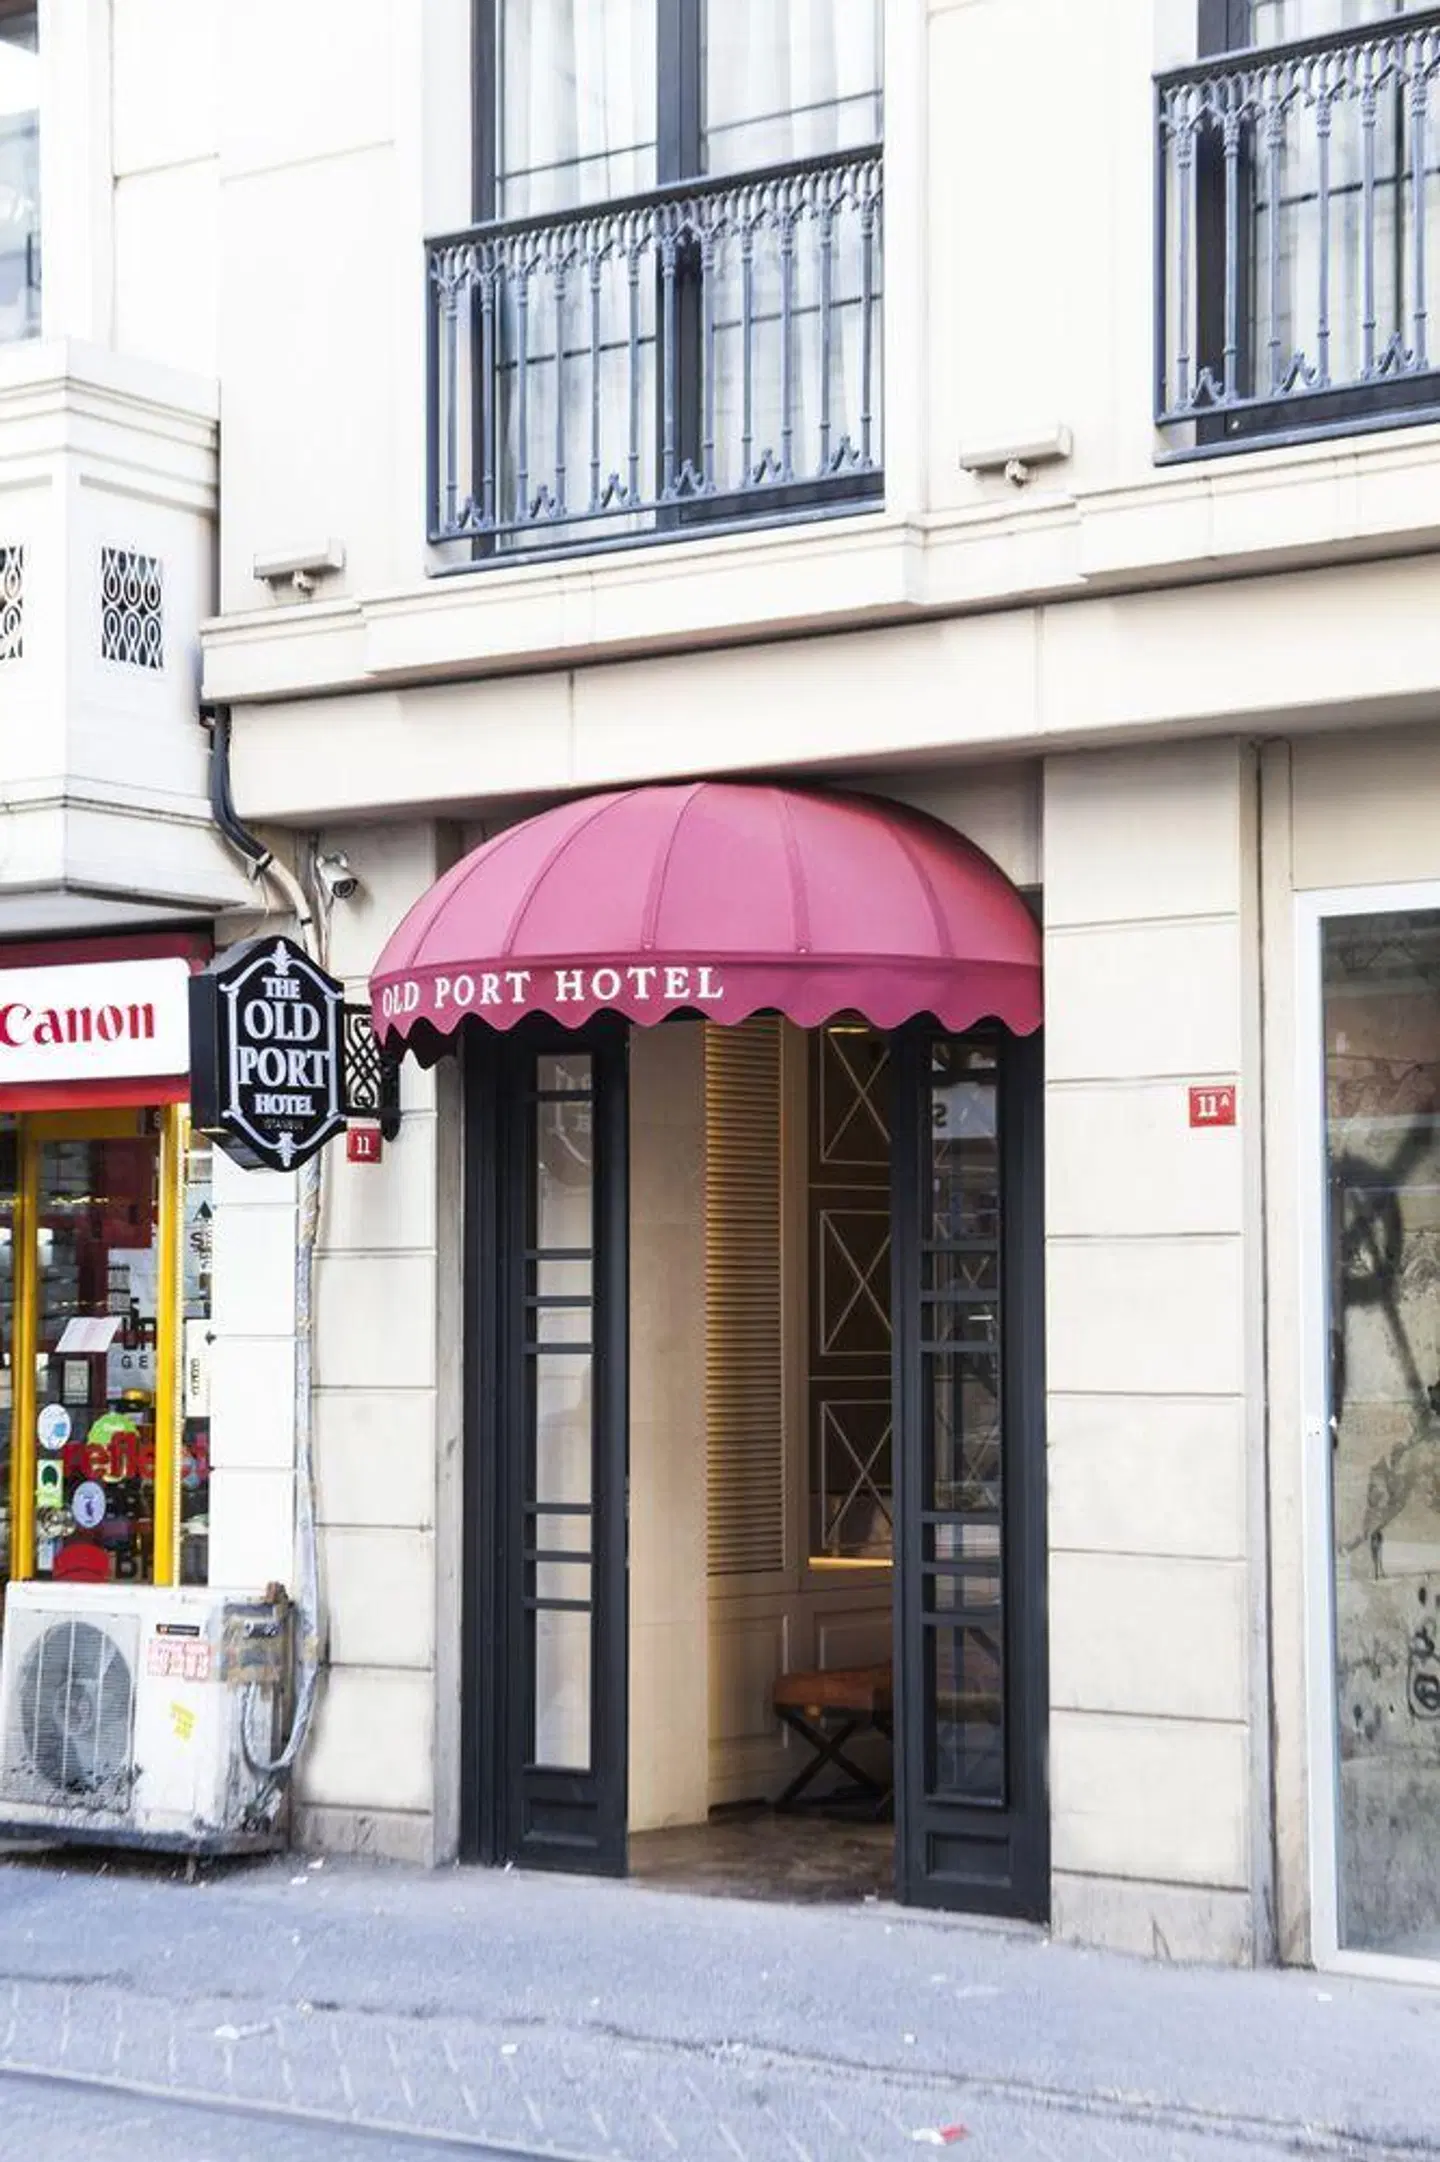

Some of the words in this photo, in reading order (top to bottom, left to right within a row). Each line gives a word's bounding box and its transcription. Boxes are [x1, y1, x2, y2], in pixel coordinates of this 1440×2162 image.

[262, 977, 301, 999] THE
[382, 981, 420, 1017] OLD
[434, 971, 531, 1008] PORT
[555, 967, 724, 1001] HOTEL
[0, 1003, 154, 1047] Canon
[244, 999, 321, 1041] OLD
[237, 1046, 328, 1088] PORT
[254, 1094, 316, 1115] HOTEL
[356, 1135, 371, 1154] 11
